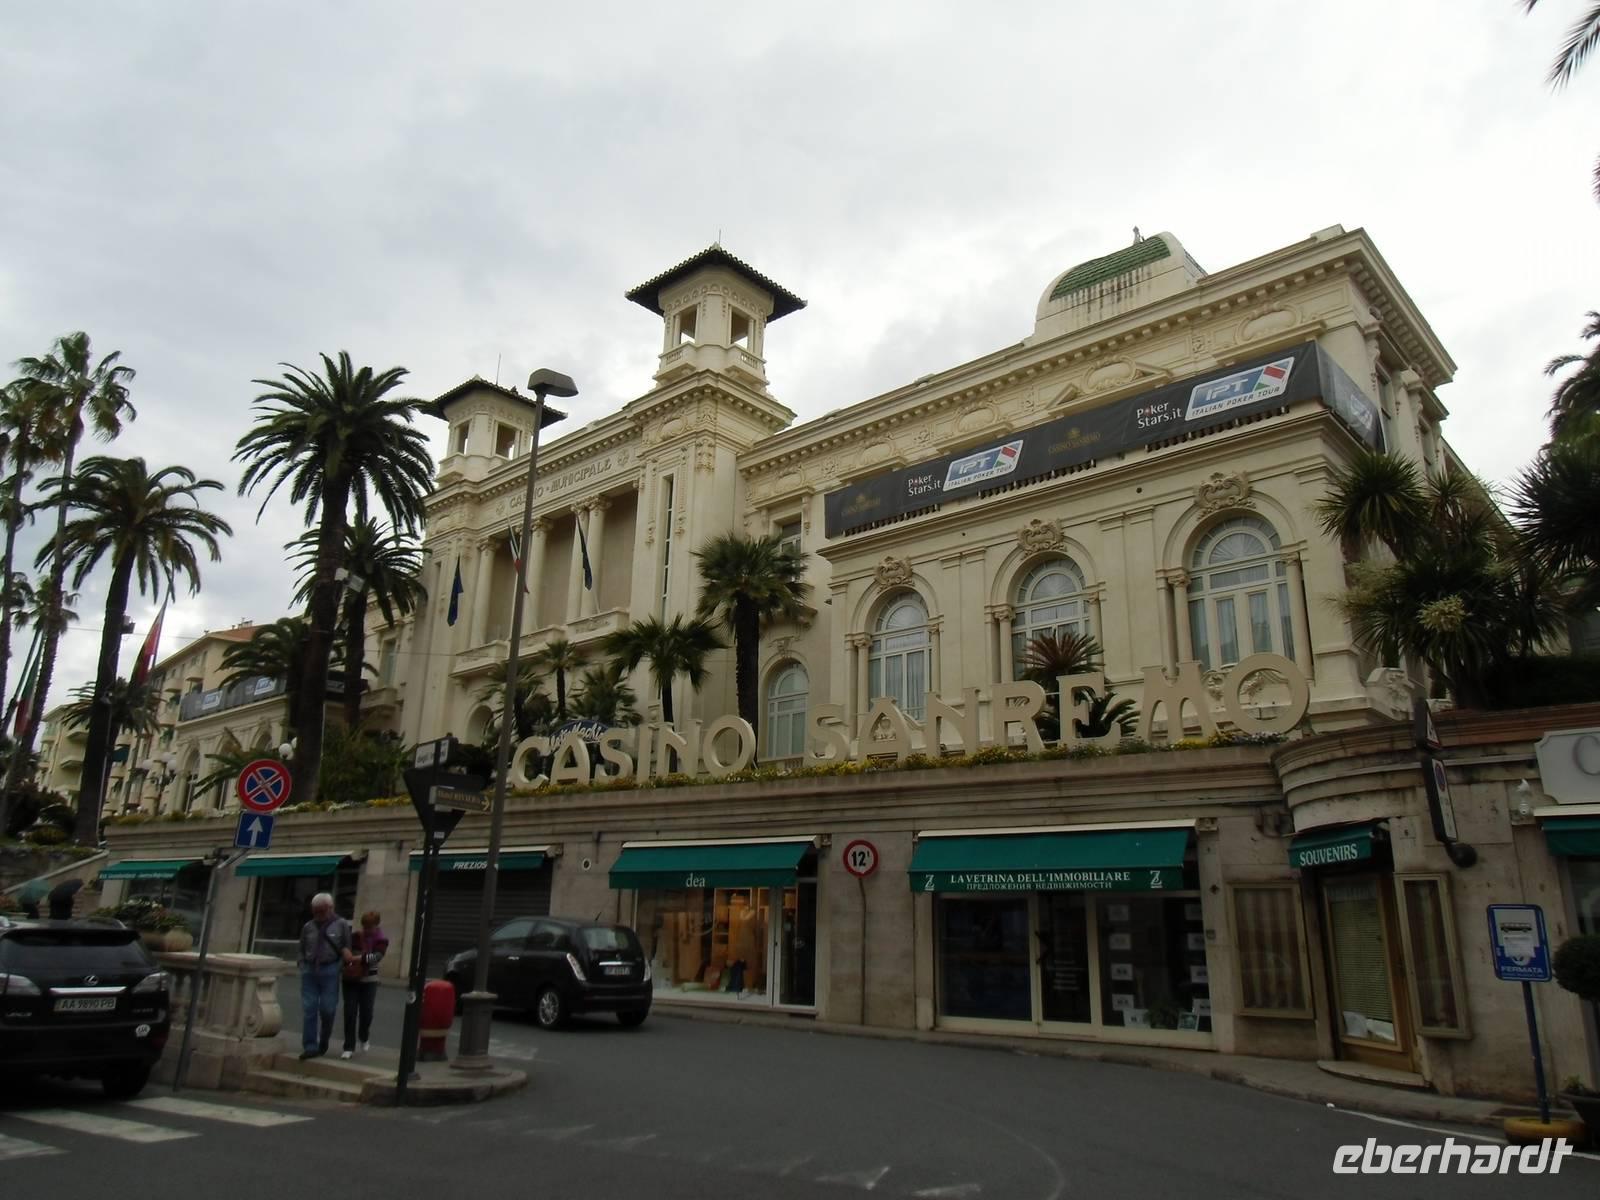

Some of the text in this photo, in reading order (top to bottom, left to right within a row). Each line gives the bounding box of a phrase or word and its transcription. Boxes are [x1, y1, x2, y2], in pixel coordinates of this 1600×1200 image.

[1206, 378, 1249, 401] IPT
[1192, 386, 1281, 417] ITALIAN POKER TOUR
[1137, 408, 1182, 429] Stars.it
[959, 456, 992, 475] IPT
[550, 457, 612, 494] MUNICIPALE
[973, 471, 995, 481] POKER
[908, 480, 941, 497] Stars.it
[512, 653, 1310, 790] CASINO SANREMO
[1300, 843, 1358, 867] SOUVENIRS
[685, 873, 706, 888] dea
[951, 874, 965, 884] LA
[966, 873, 1015, 883] VETRINA
[1017, 871, 1132, 883] DELL'IMMOBILIARE
[967, 881, 1112, 890] ПРЕДЛОЖЕНИЯ НЕДВИЖИМОСТИ
[1501, 965, 1544, 974] FERMATA
